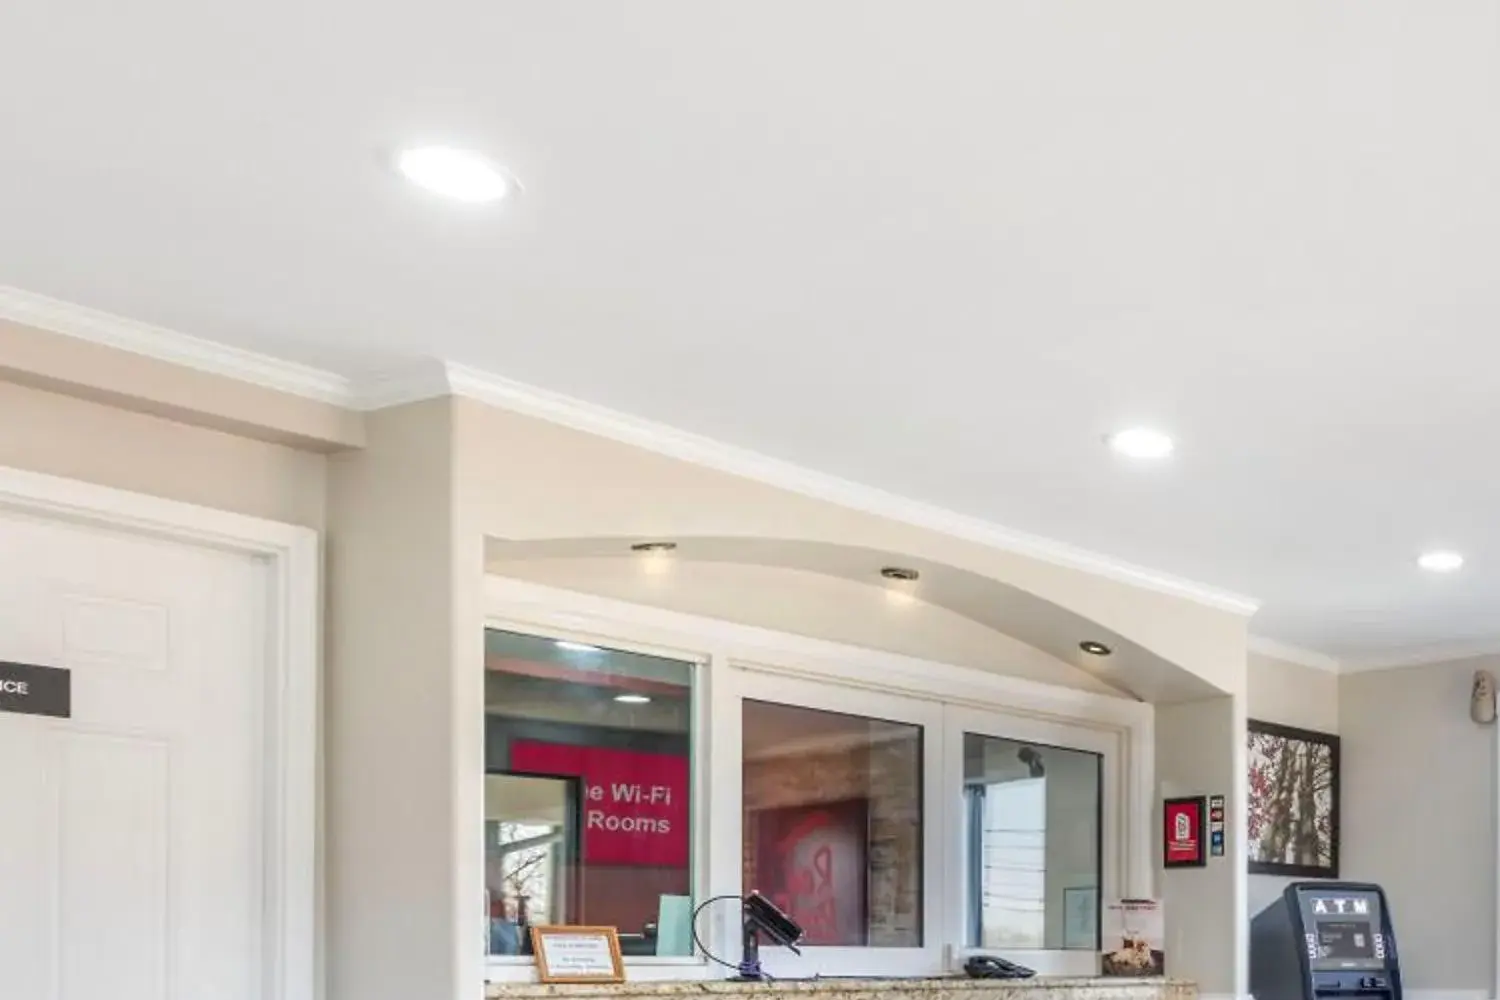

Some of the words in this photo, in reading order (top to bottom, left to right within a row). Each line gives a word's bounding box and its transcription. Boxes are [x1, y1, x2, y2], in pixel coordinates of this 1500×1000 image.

[611, 783, 672, 806] Wi-Fi
[587, 809, 671, 834] Rooms
[1315, 898, 1368, 914] ATM
